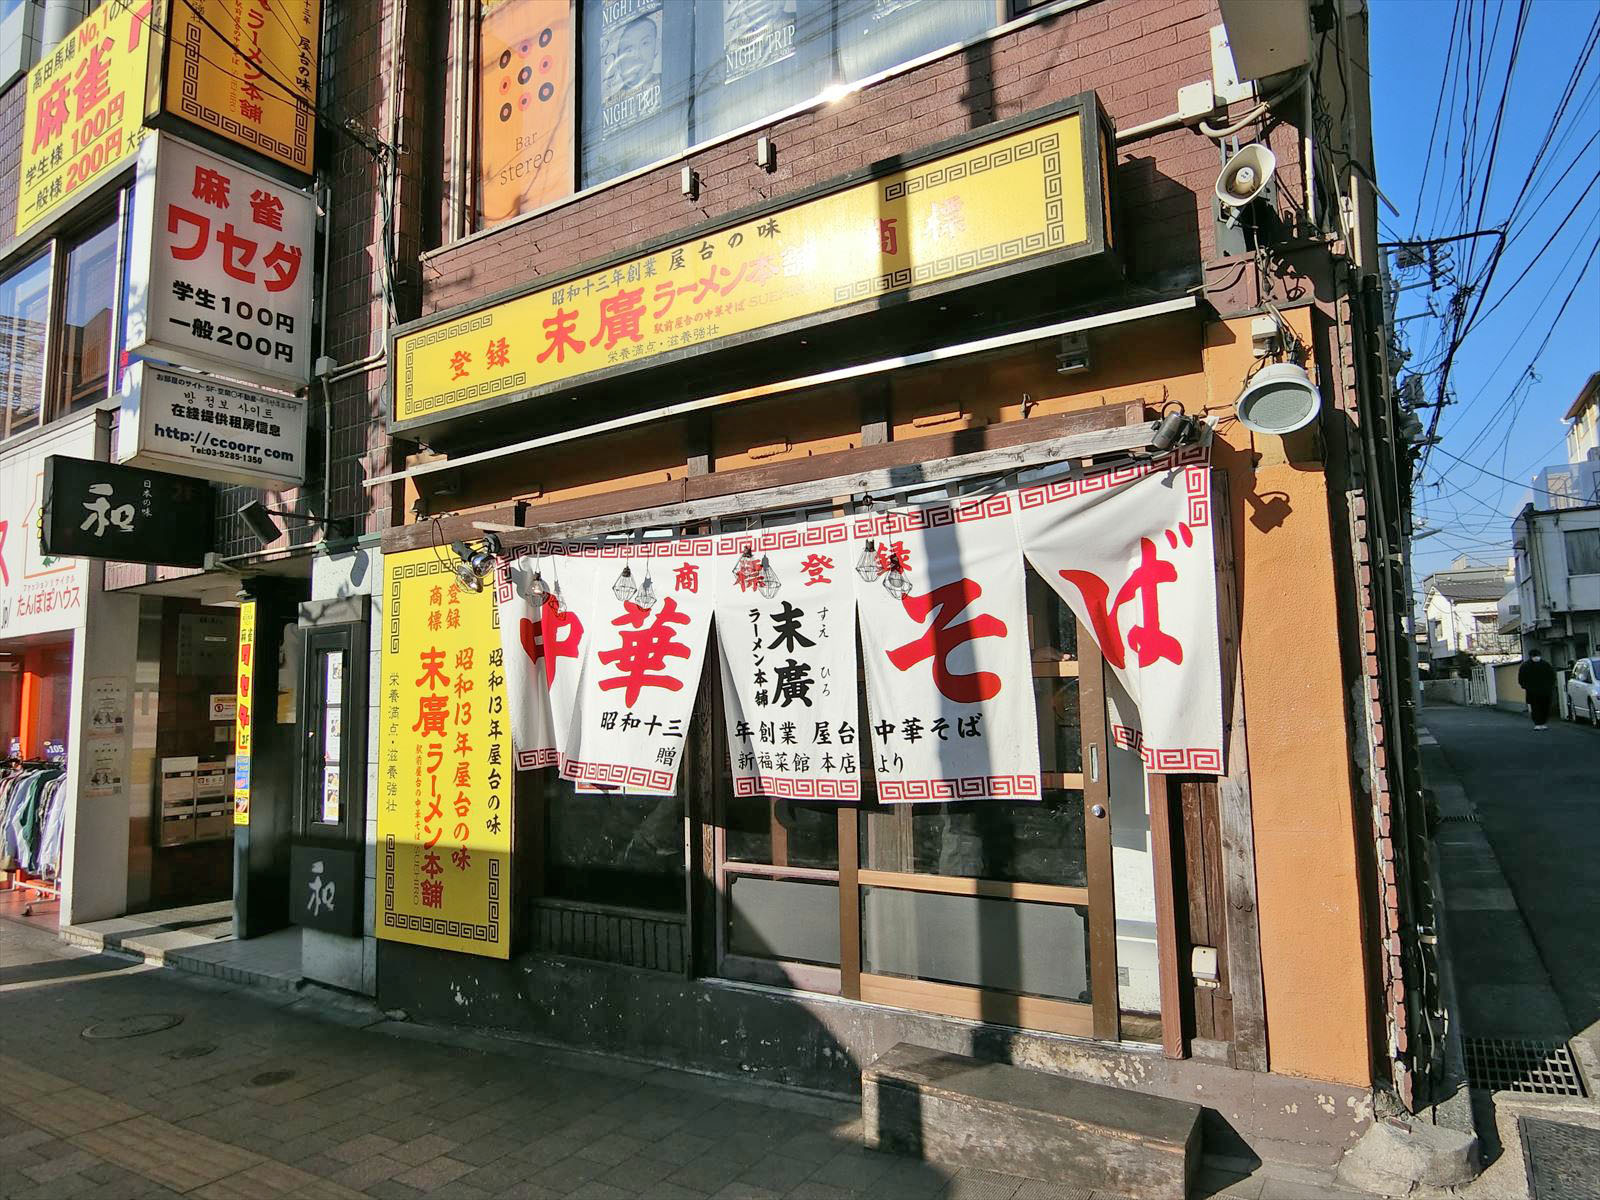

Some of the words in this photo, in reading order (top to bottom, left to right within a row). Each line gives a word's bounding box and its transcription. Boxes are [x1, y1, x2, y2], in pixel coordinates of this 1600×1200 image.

[33, 36, 76, 94] 高田馬場
[297, 35, 313, 93] 屋台の味
[726, 39, 764, 73] NIGHT
[768, 25, 796, 54] TRIP
[31, 36, 115, 156] 麻雀
[71, 91, 125, 156] 100円
[602, 97, 635, 128] NIGHT
[637, 85, 661, 113] TRIP
[65, 127, 123, 194] 200円
[500, 149, 554, 186] stereo
[515, 132, 538, 151] Bar
[191, 164, 285, 233] 麻雀
[167, 203, 303, 293] ワセダ
[668, 217, 782, 272] 屋台の味
[171, 280, 295, 335] 学生100円
[168, 317, 294, 364] 一般200円
[449, 337, 510, 381] 登録
[154, 423, 294, 463] http://ccoorrcom
[17, 586, 81, 616] たんぽぽハウス
[748, 607, 769, 709] ラーメン本舗
[768, 600, 817, 708] 末廣
[487, 647, 504, 836] 昭和13年屋台の味
[874, 712, 984, 745] 中華そば
[451, 647, 475, 872] 昭和13年屋台の味
[656, 746, 677, 767] 贈
[877, 752, 905, 775] より
